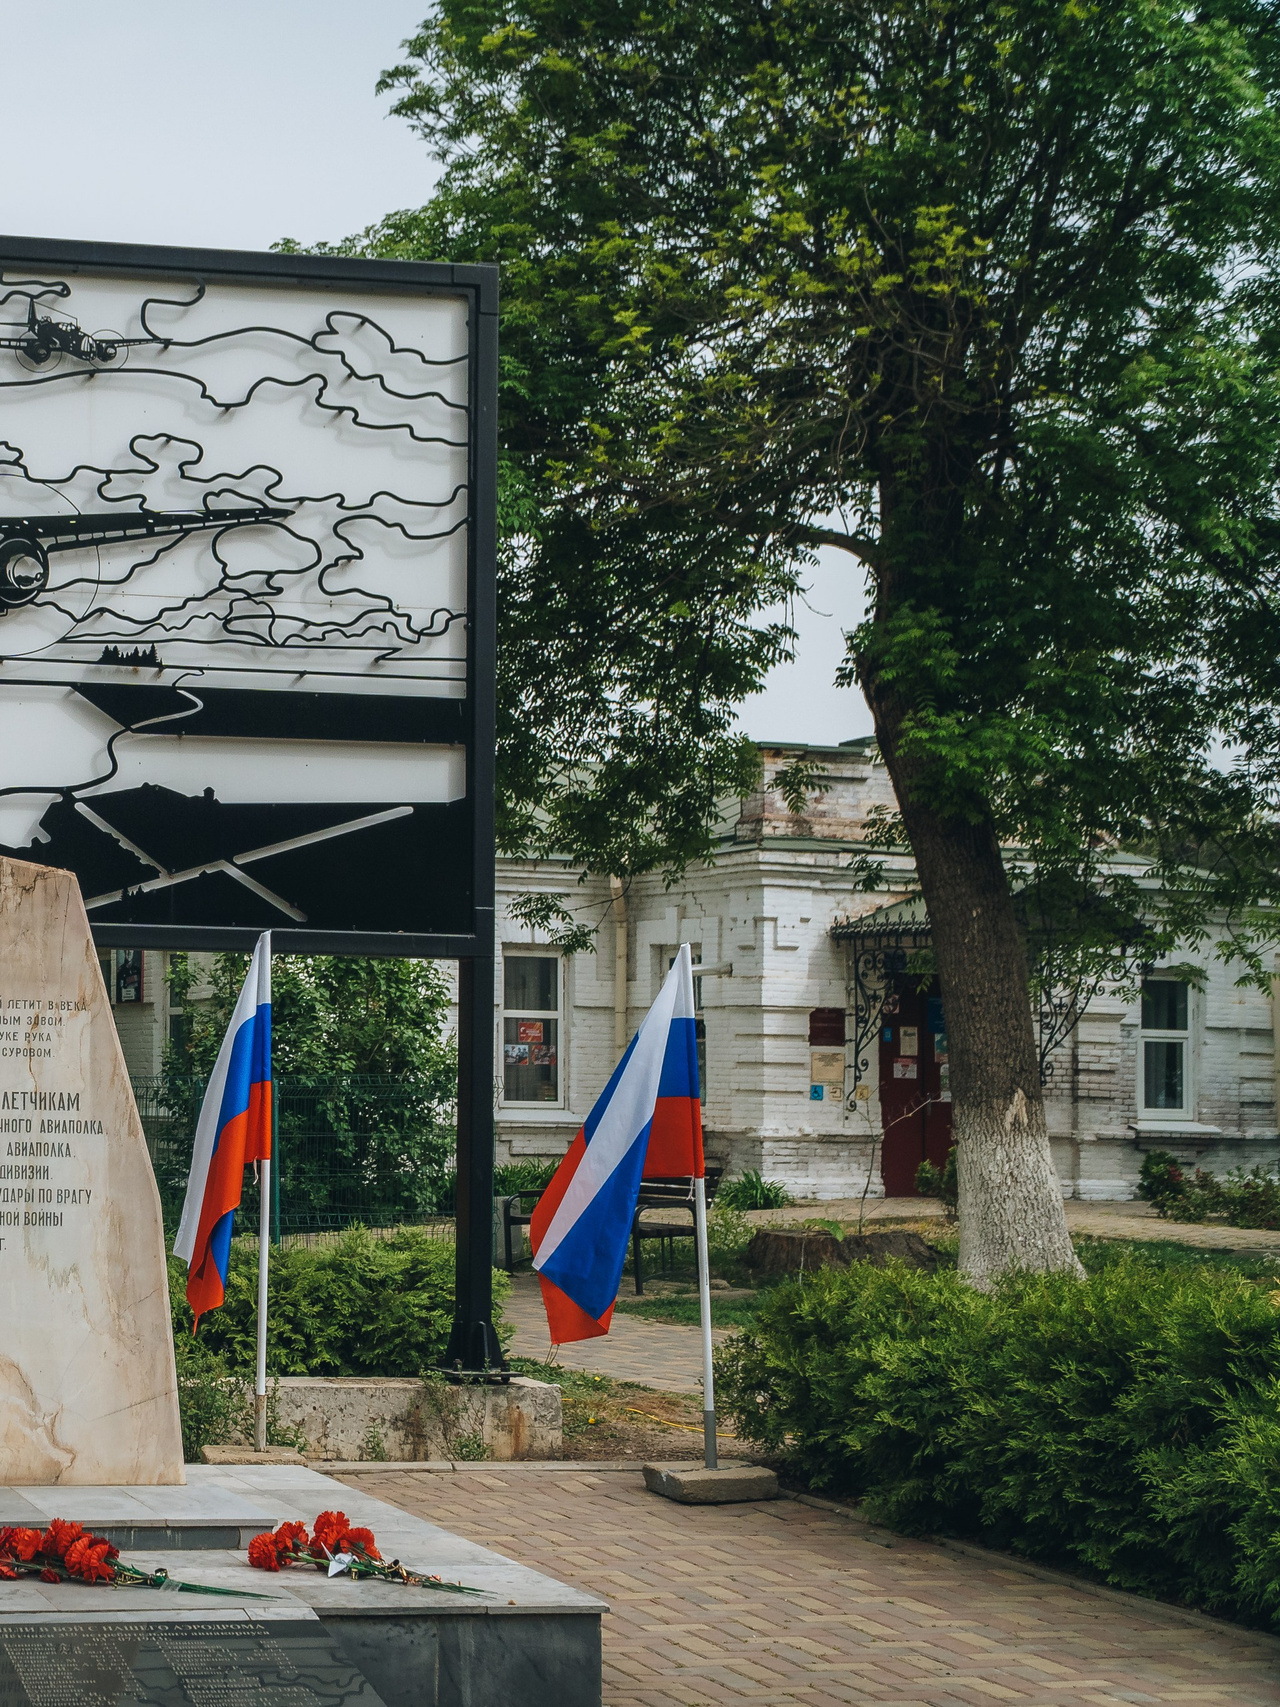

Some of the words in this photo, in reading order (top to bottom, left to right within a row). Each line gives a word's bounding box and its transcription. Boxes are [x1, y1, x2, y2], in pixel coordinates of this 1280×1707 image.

[7, 999, 42, 1010] ЛЕТИТ
[48, 1000, 54, 1011] В
[60, 999, 87, 1012] ВЕКА
[24, 1032, 52, 1042] РУКА
[2, 1047, 56, 1058] СУРОВОМ.
[1, 1091, 80, 1111] ЛЕТЧИКАМ
[38, 1188, 52, 1204] ПО
[56, 1189, 92, 1205] ВРАГУ
[23, 1208, 63, 1227] ВОЙНЫ
[173, 1623, 266, 1631] АЭРОДРОМА
